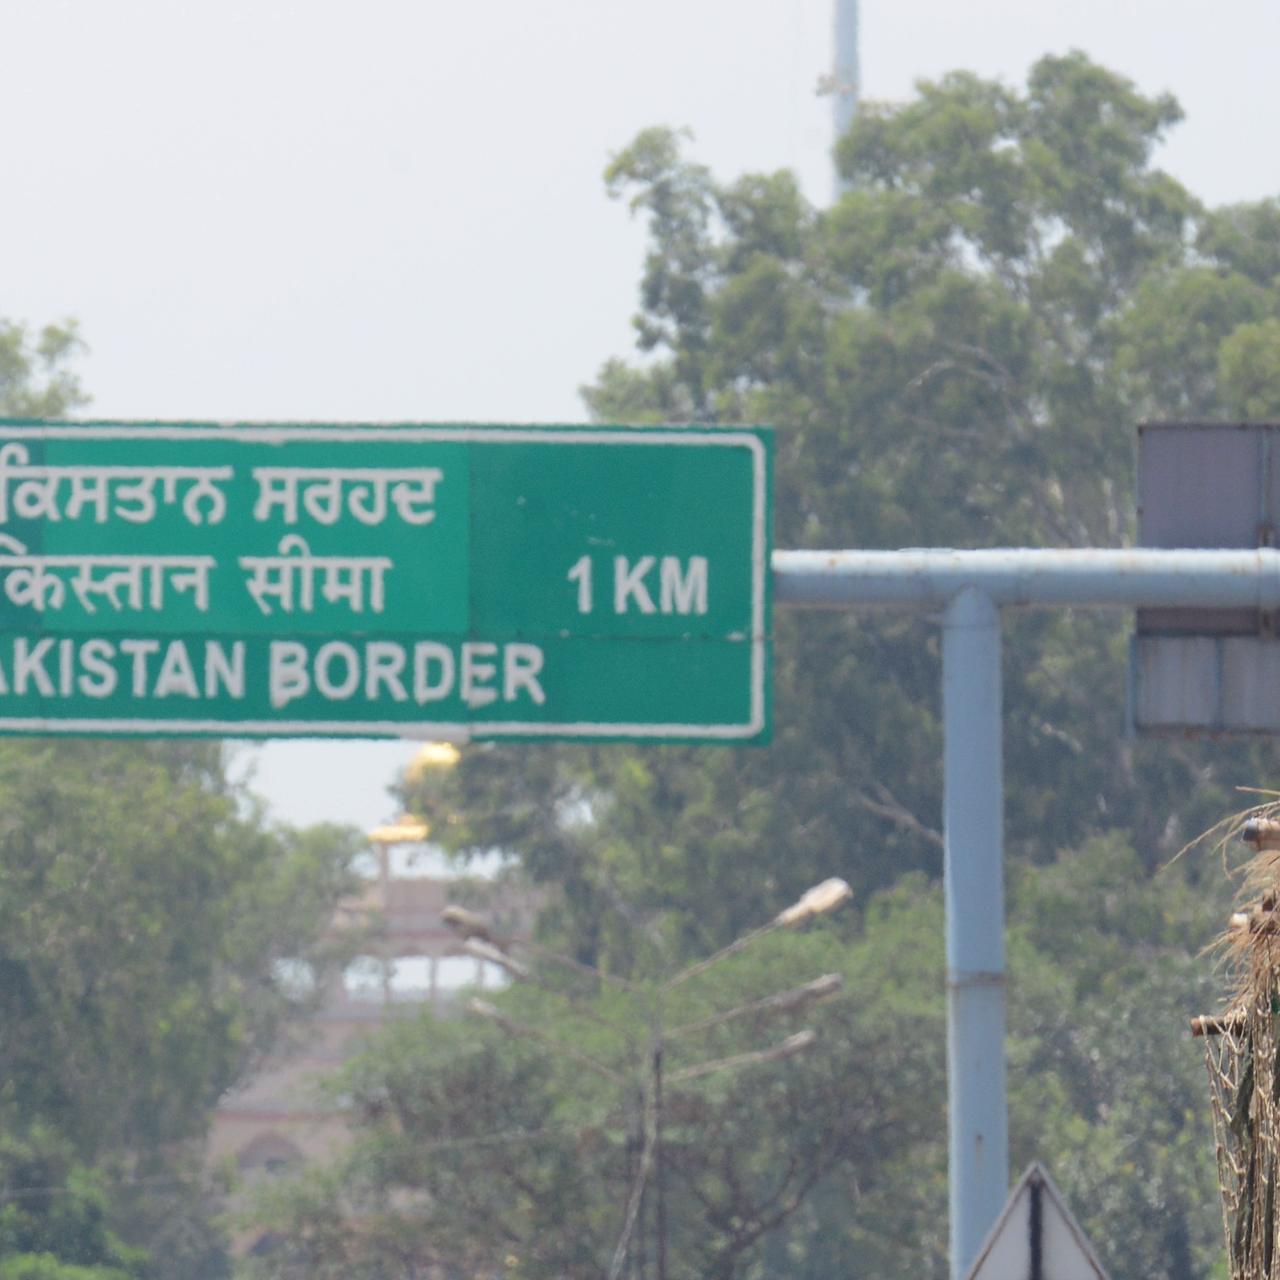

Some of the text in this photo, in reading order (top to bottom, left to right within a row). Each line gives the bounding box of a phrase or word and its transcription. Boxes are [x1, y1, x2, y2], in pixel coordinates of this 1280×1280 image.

[252, 466, 443, 524] ਸਰਹਦ
[238, 533, 394, 615] सीमा
[568, 556, 708, 614] 1 KM
[269, 641, 547, 707] BORDER
